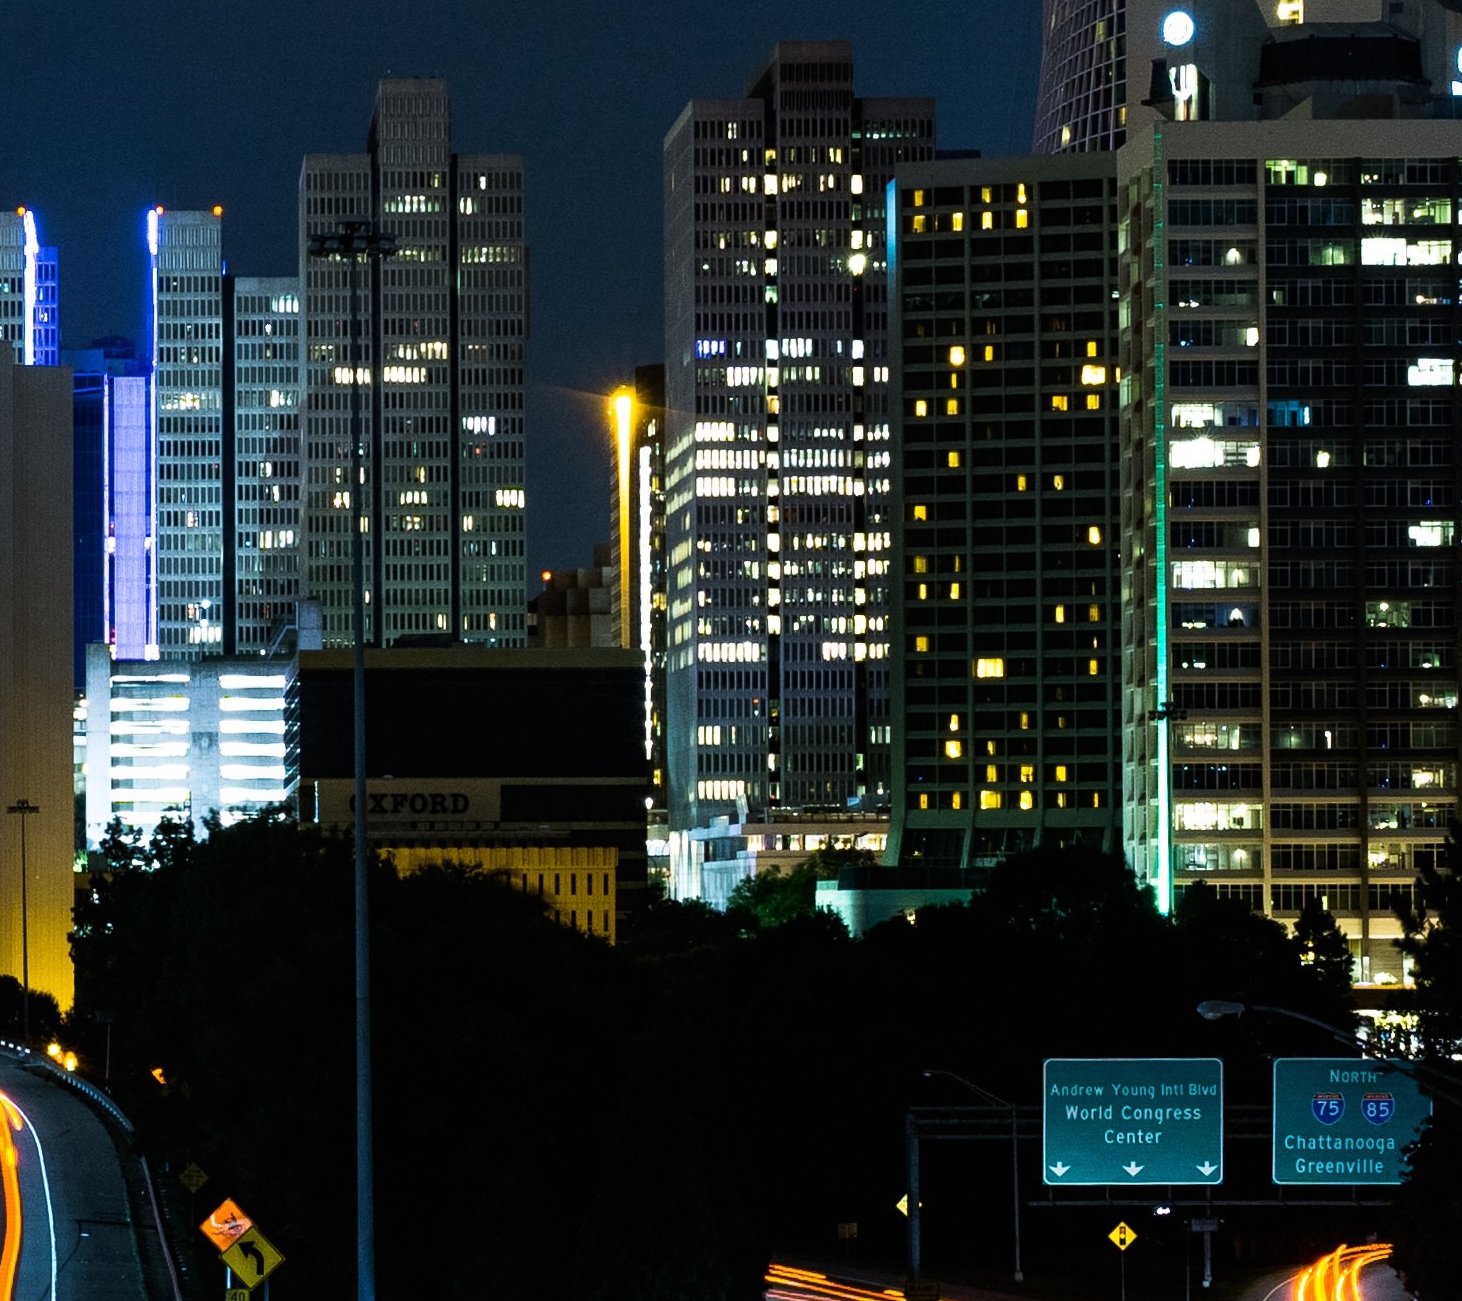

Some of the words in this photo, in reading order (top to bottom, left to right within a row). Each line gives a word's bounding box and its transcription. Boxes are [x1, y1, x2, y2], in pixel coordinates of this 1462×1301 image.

[1330, 1069, 1378, 1083] NORTH
[1050, 1084, 1105, 1096] Andrew
[1111, 1084, 1156, 1099] Young
[1188, 1084, 1218, 1096] Blvd
[1065, 1105, 1113, 1120] World
[1121, 1105, 1202, 1124] Congress
[1317, 1100, 1340, 1116] 75
[1366, 1102, 1390, 1117] 85
[1104, 1129, 1162, 1144] Center
[1284, 1135, 1395, 1155] Chattanooga
[1295, 1158, 1385, 1174] Greenville
